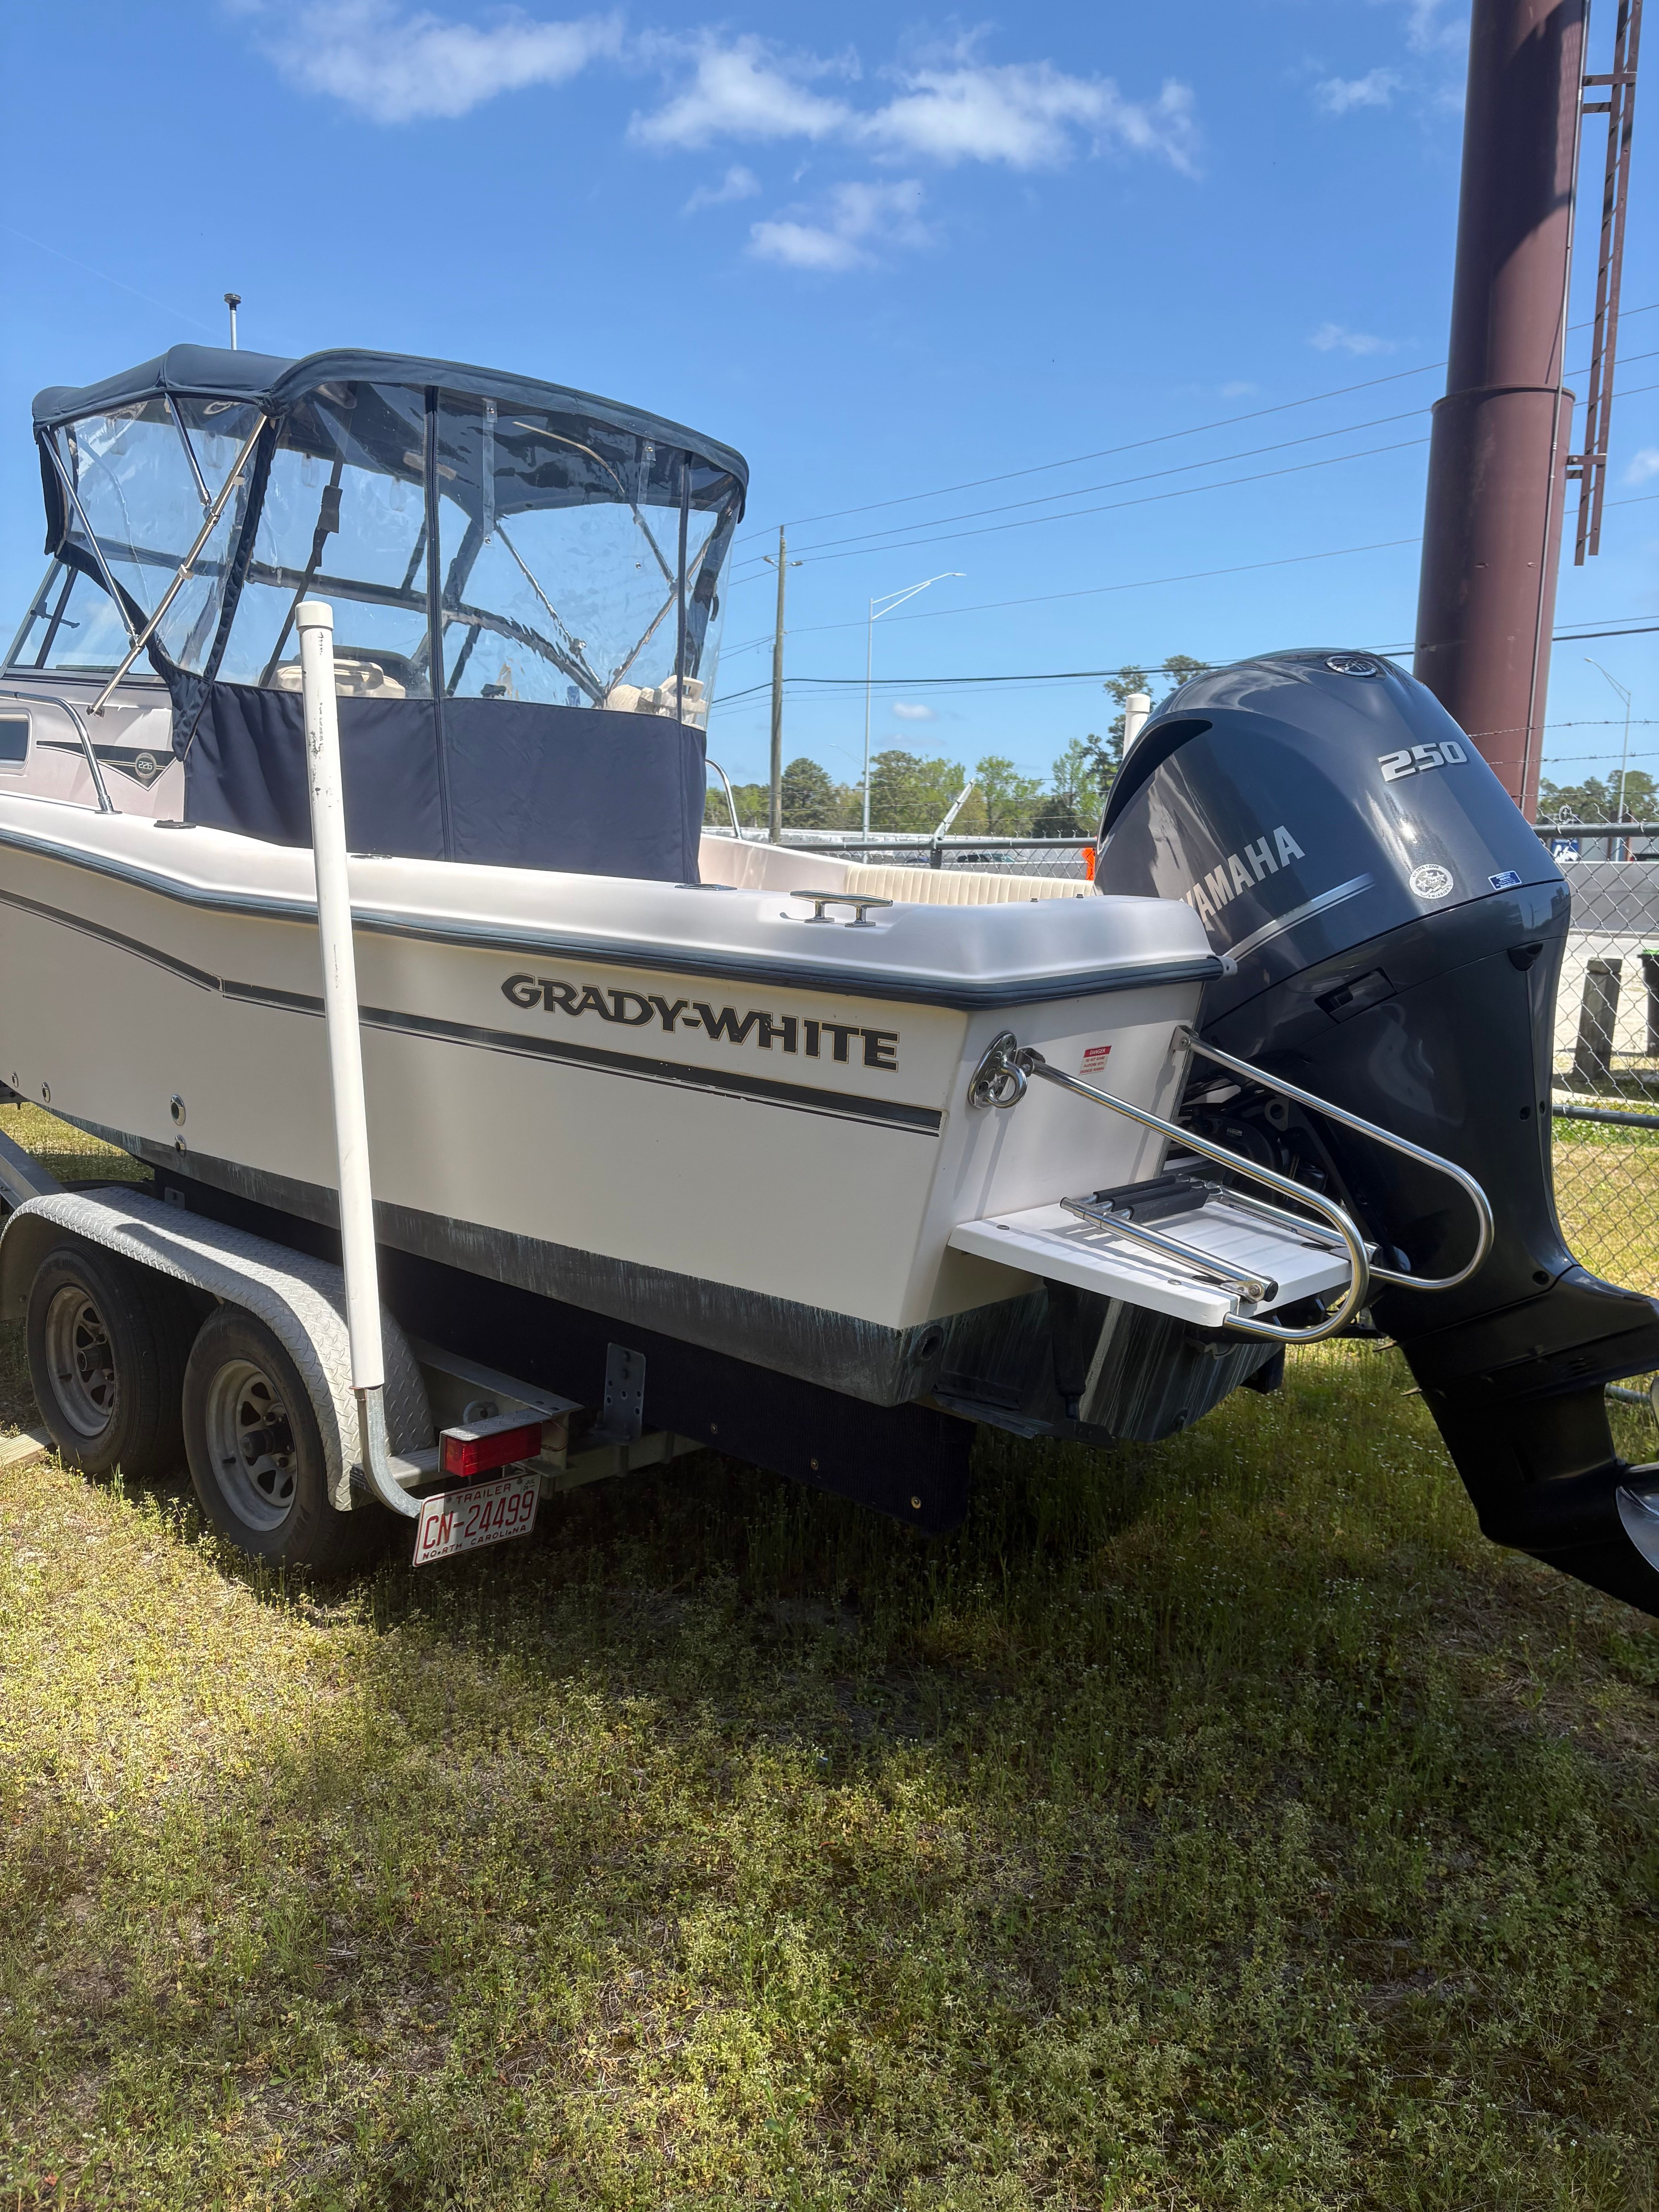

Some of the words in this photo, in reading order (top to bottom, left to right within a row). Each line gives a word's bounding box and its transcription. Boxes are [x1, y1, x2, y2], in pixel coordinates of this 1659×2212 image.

[138, 761, 153, 770] 226
[1377, 741, 1467, 782] 250
[501, 972, 900, 1072] GRADY-WHITE
[456, 1483, 512, 1504] TRAILER
[422, 1490, 534, 1549] CN-24499
[422, 1542, 462, 1560] NORTH
[471, 1524, 527, 1545] CAROLINA
